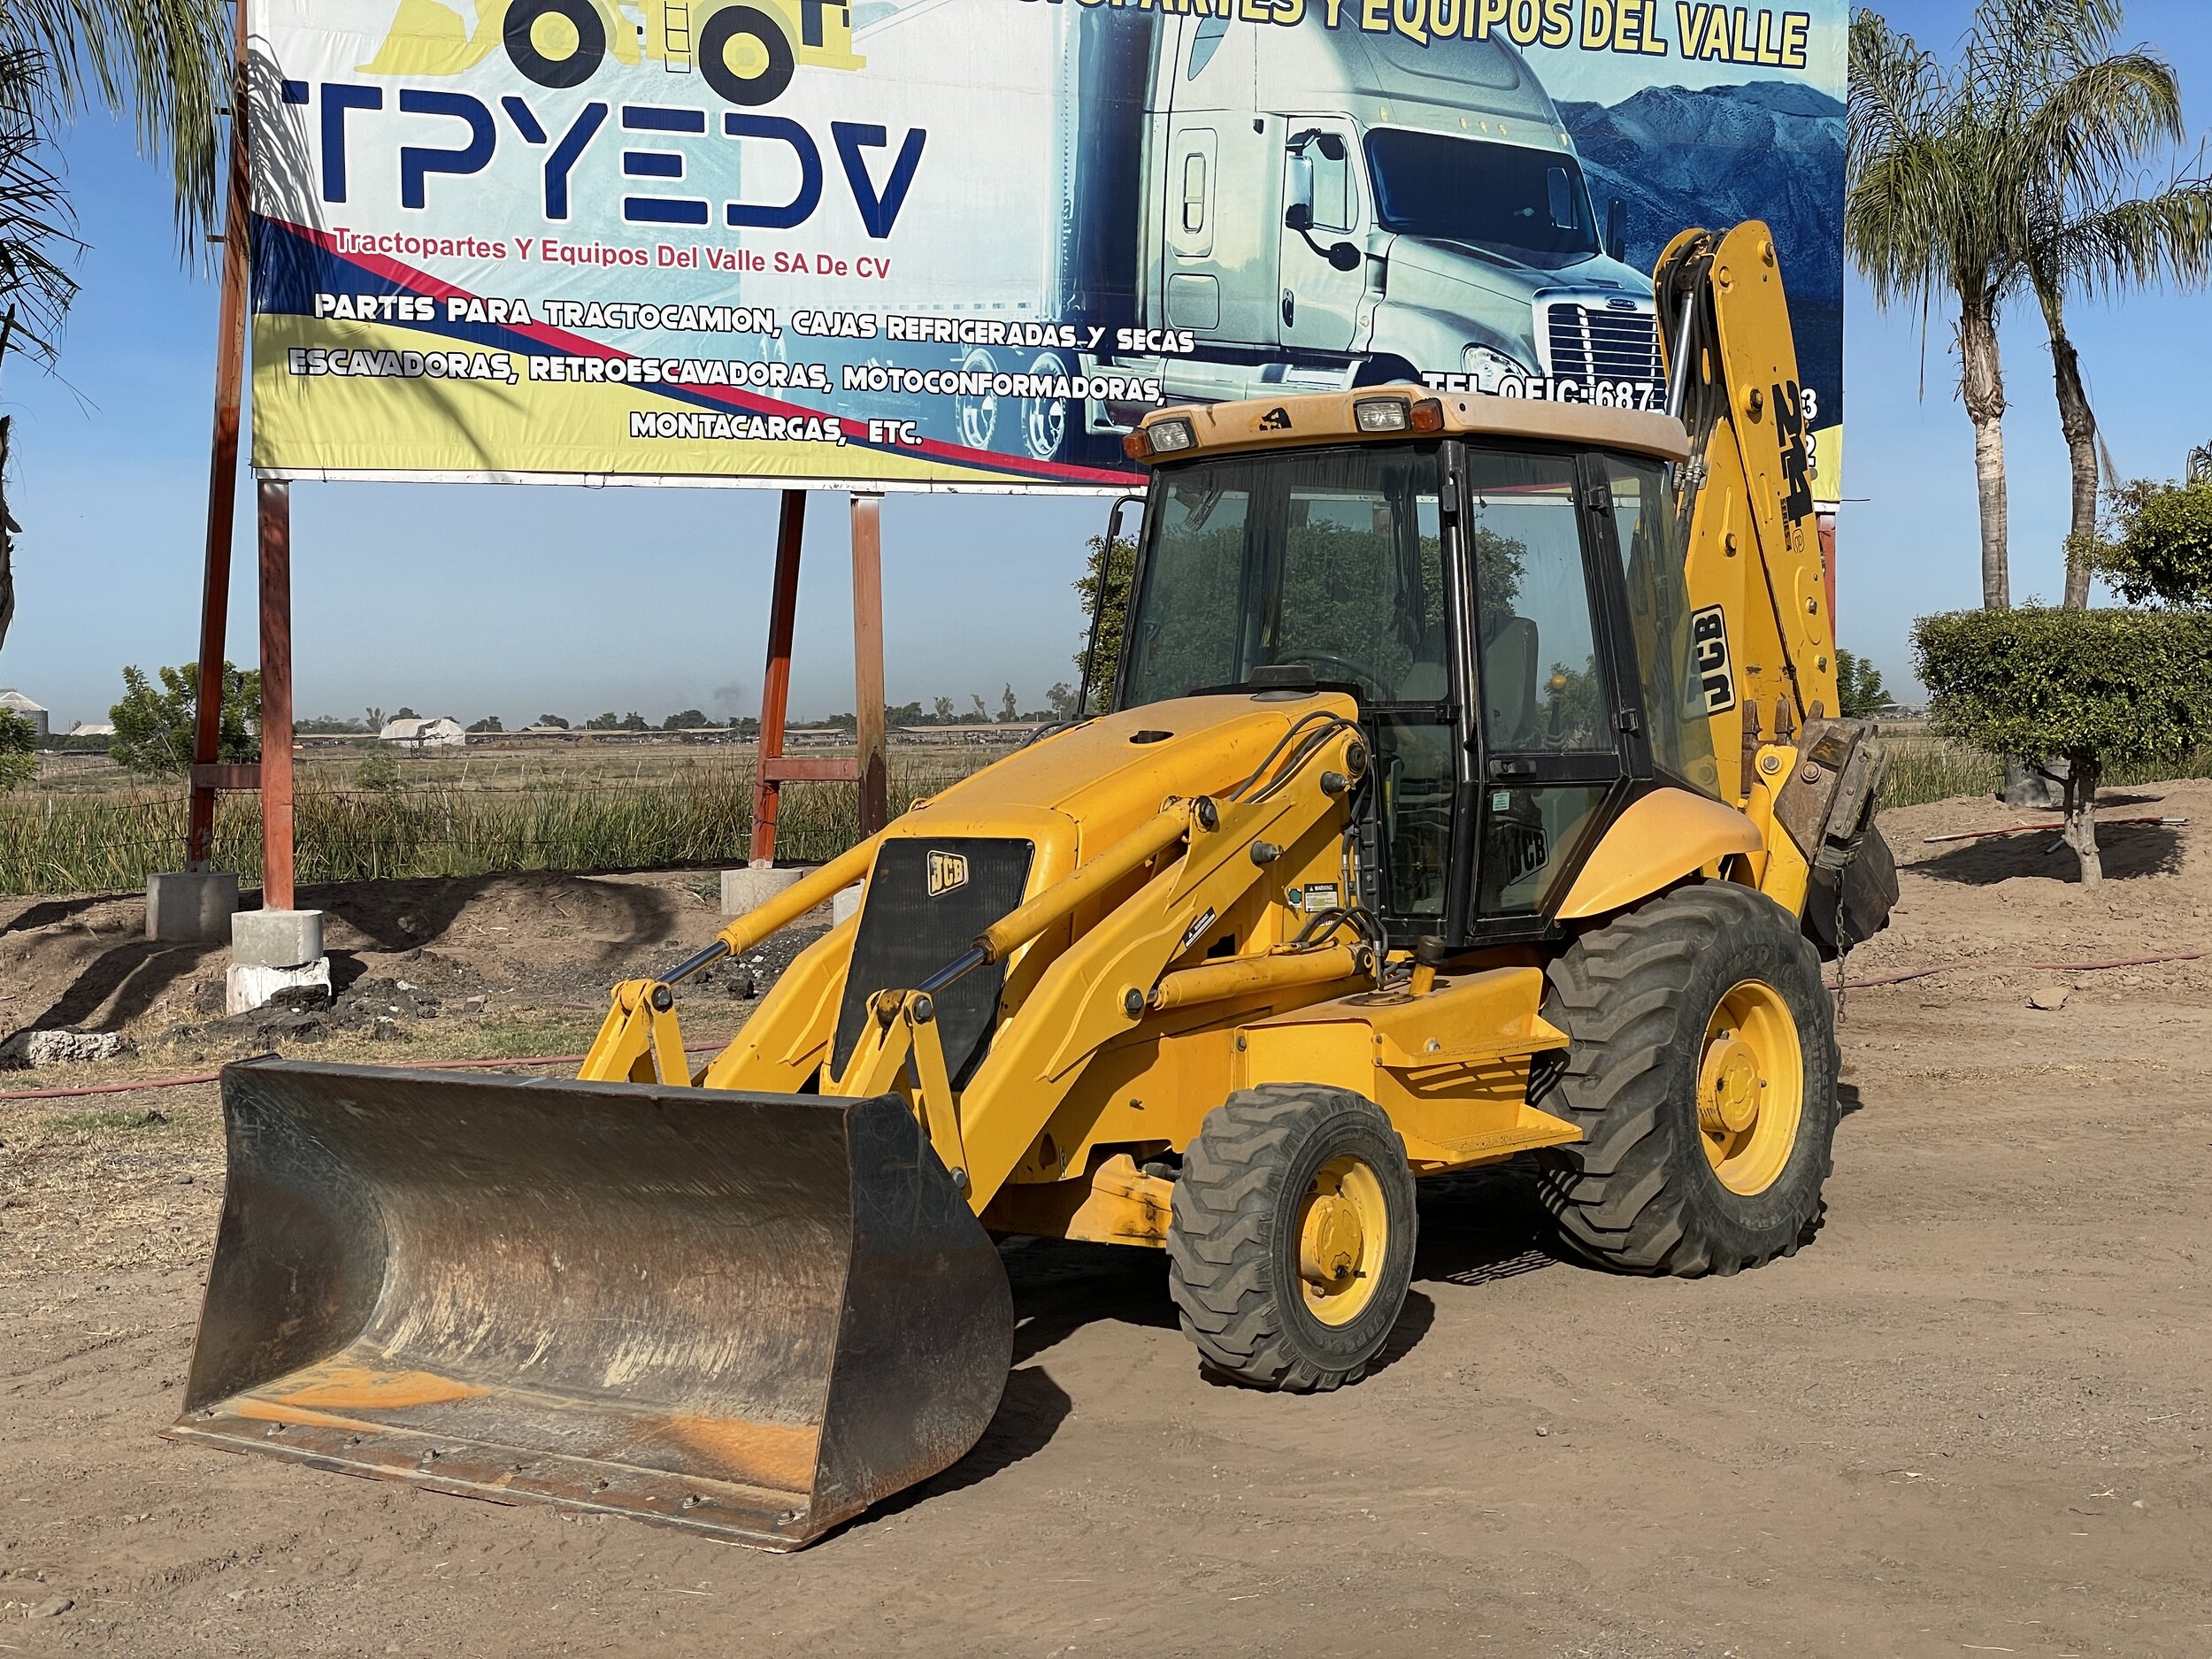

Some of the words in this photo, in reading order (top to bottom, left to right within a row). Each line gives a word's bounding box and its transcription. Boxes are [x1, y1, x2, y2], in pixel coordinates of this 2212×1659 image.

[1359, 0, 1573, 48] EQUIPOS
[1579, 0, 1668, 56] DEL
[1676, 2, 1810, 69] VALLE
[281, 79, 927, 240] TPYEDV
[333, 227, 507, 259] Tractopartes
[514, 238, 534, 260] Y
[541, 240, 649, 268] Equipos
[657, 245, 698, 268] Del
[705, 247, 765, 272] Valle
[773, 251, 809, 273] SA
[817, 255, 848, 276] De
[856, 257, 891, 279] CV
[313, 293, 436, 322] PARTES
[447, 296, 533, 326] PARA
[543, 300, 782, 339] TRACTOCAMION,
[792, 311, 878, 339] CAJAS
[886, 315, 1078, 349] REFRIGERADAS
[1086, 326, 1106, 349] Y
[1116, 327, 1195, 353] SECAS
[288, 348, 519, 385] ESCAVADORAS,
[529, 356, 833, 394] RETROESCAVADORAS,
[842, 365, 1166, 407] MOTOCONFORMADORAS,
[629, 411, 847, 447] MONTACARGAS,
[868, 419, 924, 445] ETC.
[1686, 613, 1732, 707] JCB
[931, 856, 964, 894] JCB
[1509, 826, 1547, 885] JCB
